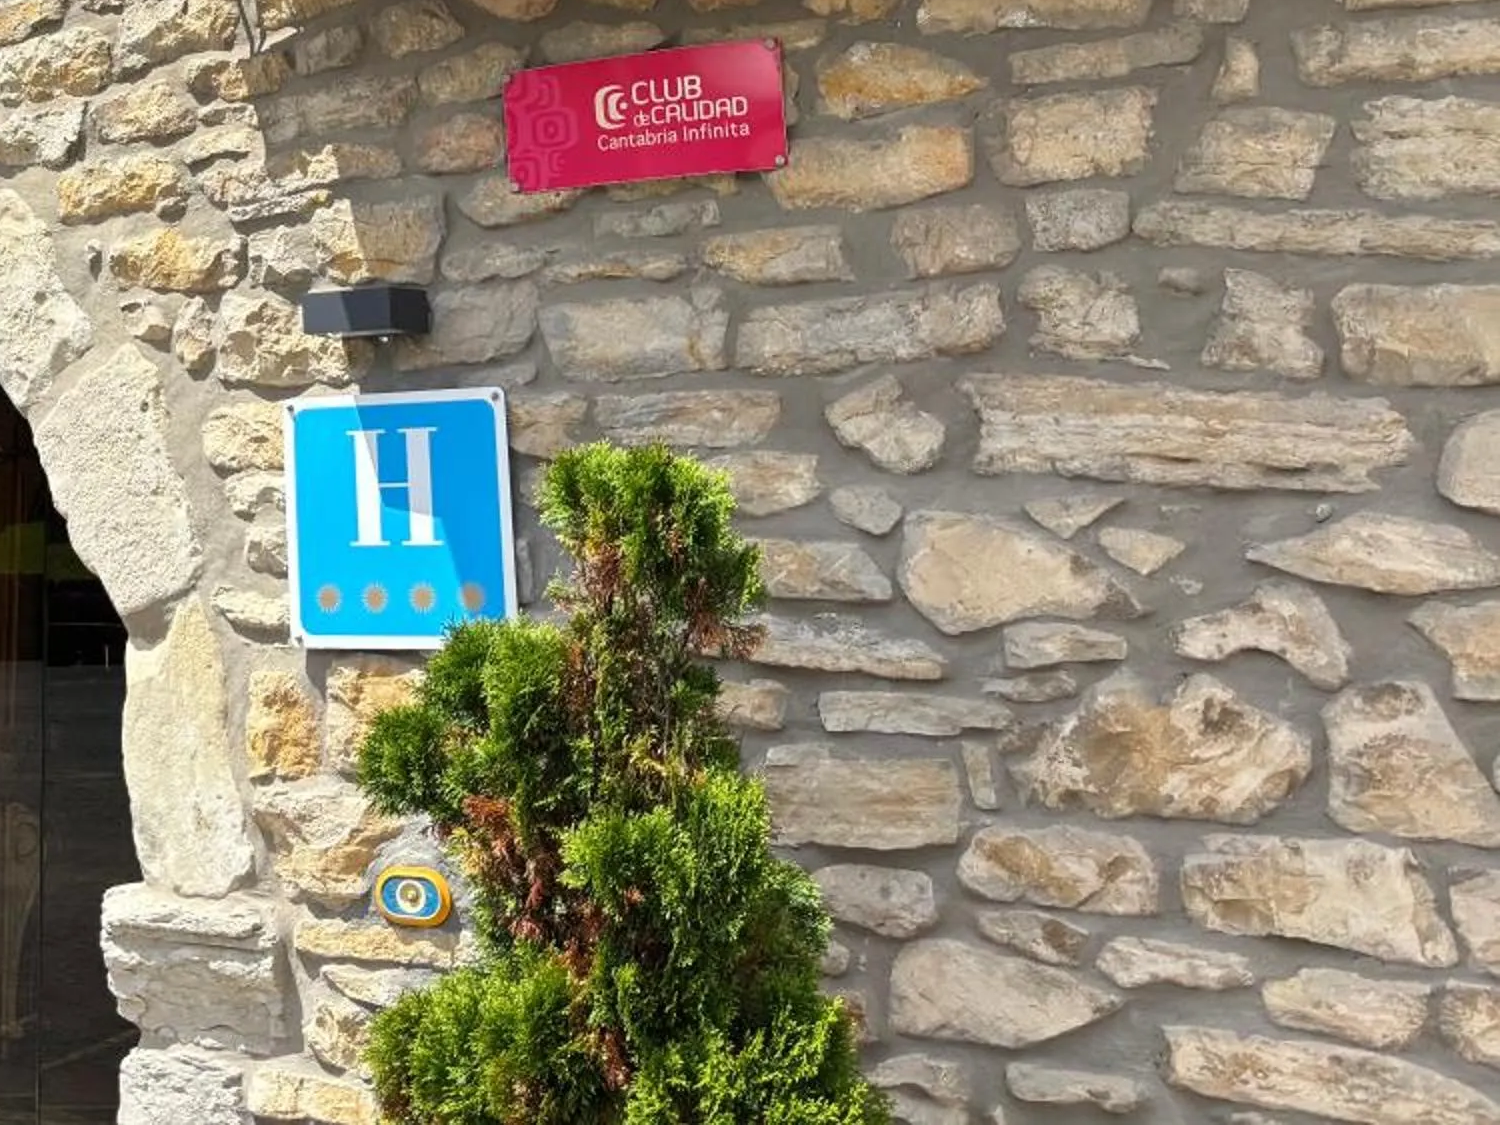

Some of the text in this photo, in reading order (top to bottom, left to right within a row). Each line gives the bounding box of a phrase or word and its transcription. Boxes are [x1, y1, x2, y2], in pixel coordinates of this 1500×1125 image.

[631, 74, 703, 105] CLUB
[633, 96, 748, 127] de CALIDAD
[597, 121, 750, 151] Cantabria Infinita
[345, 426, 445, 547] H
